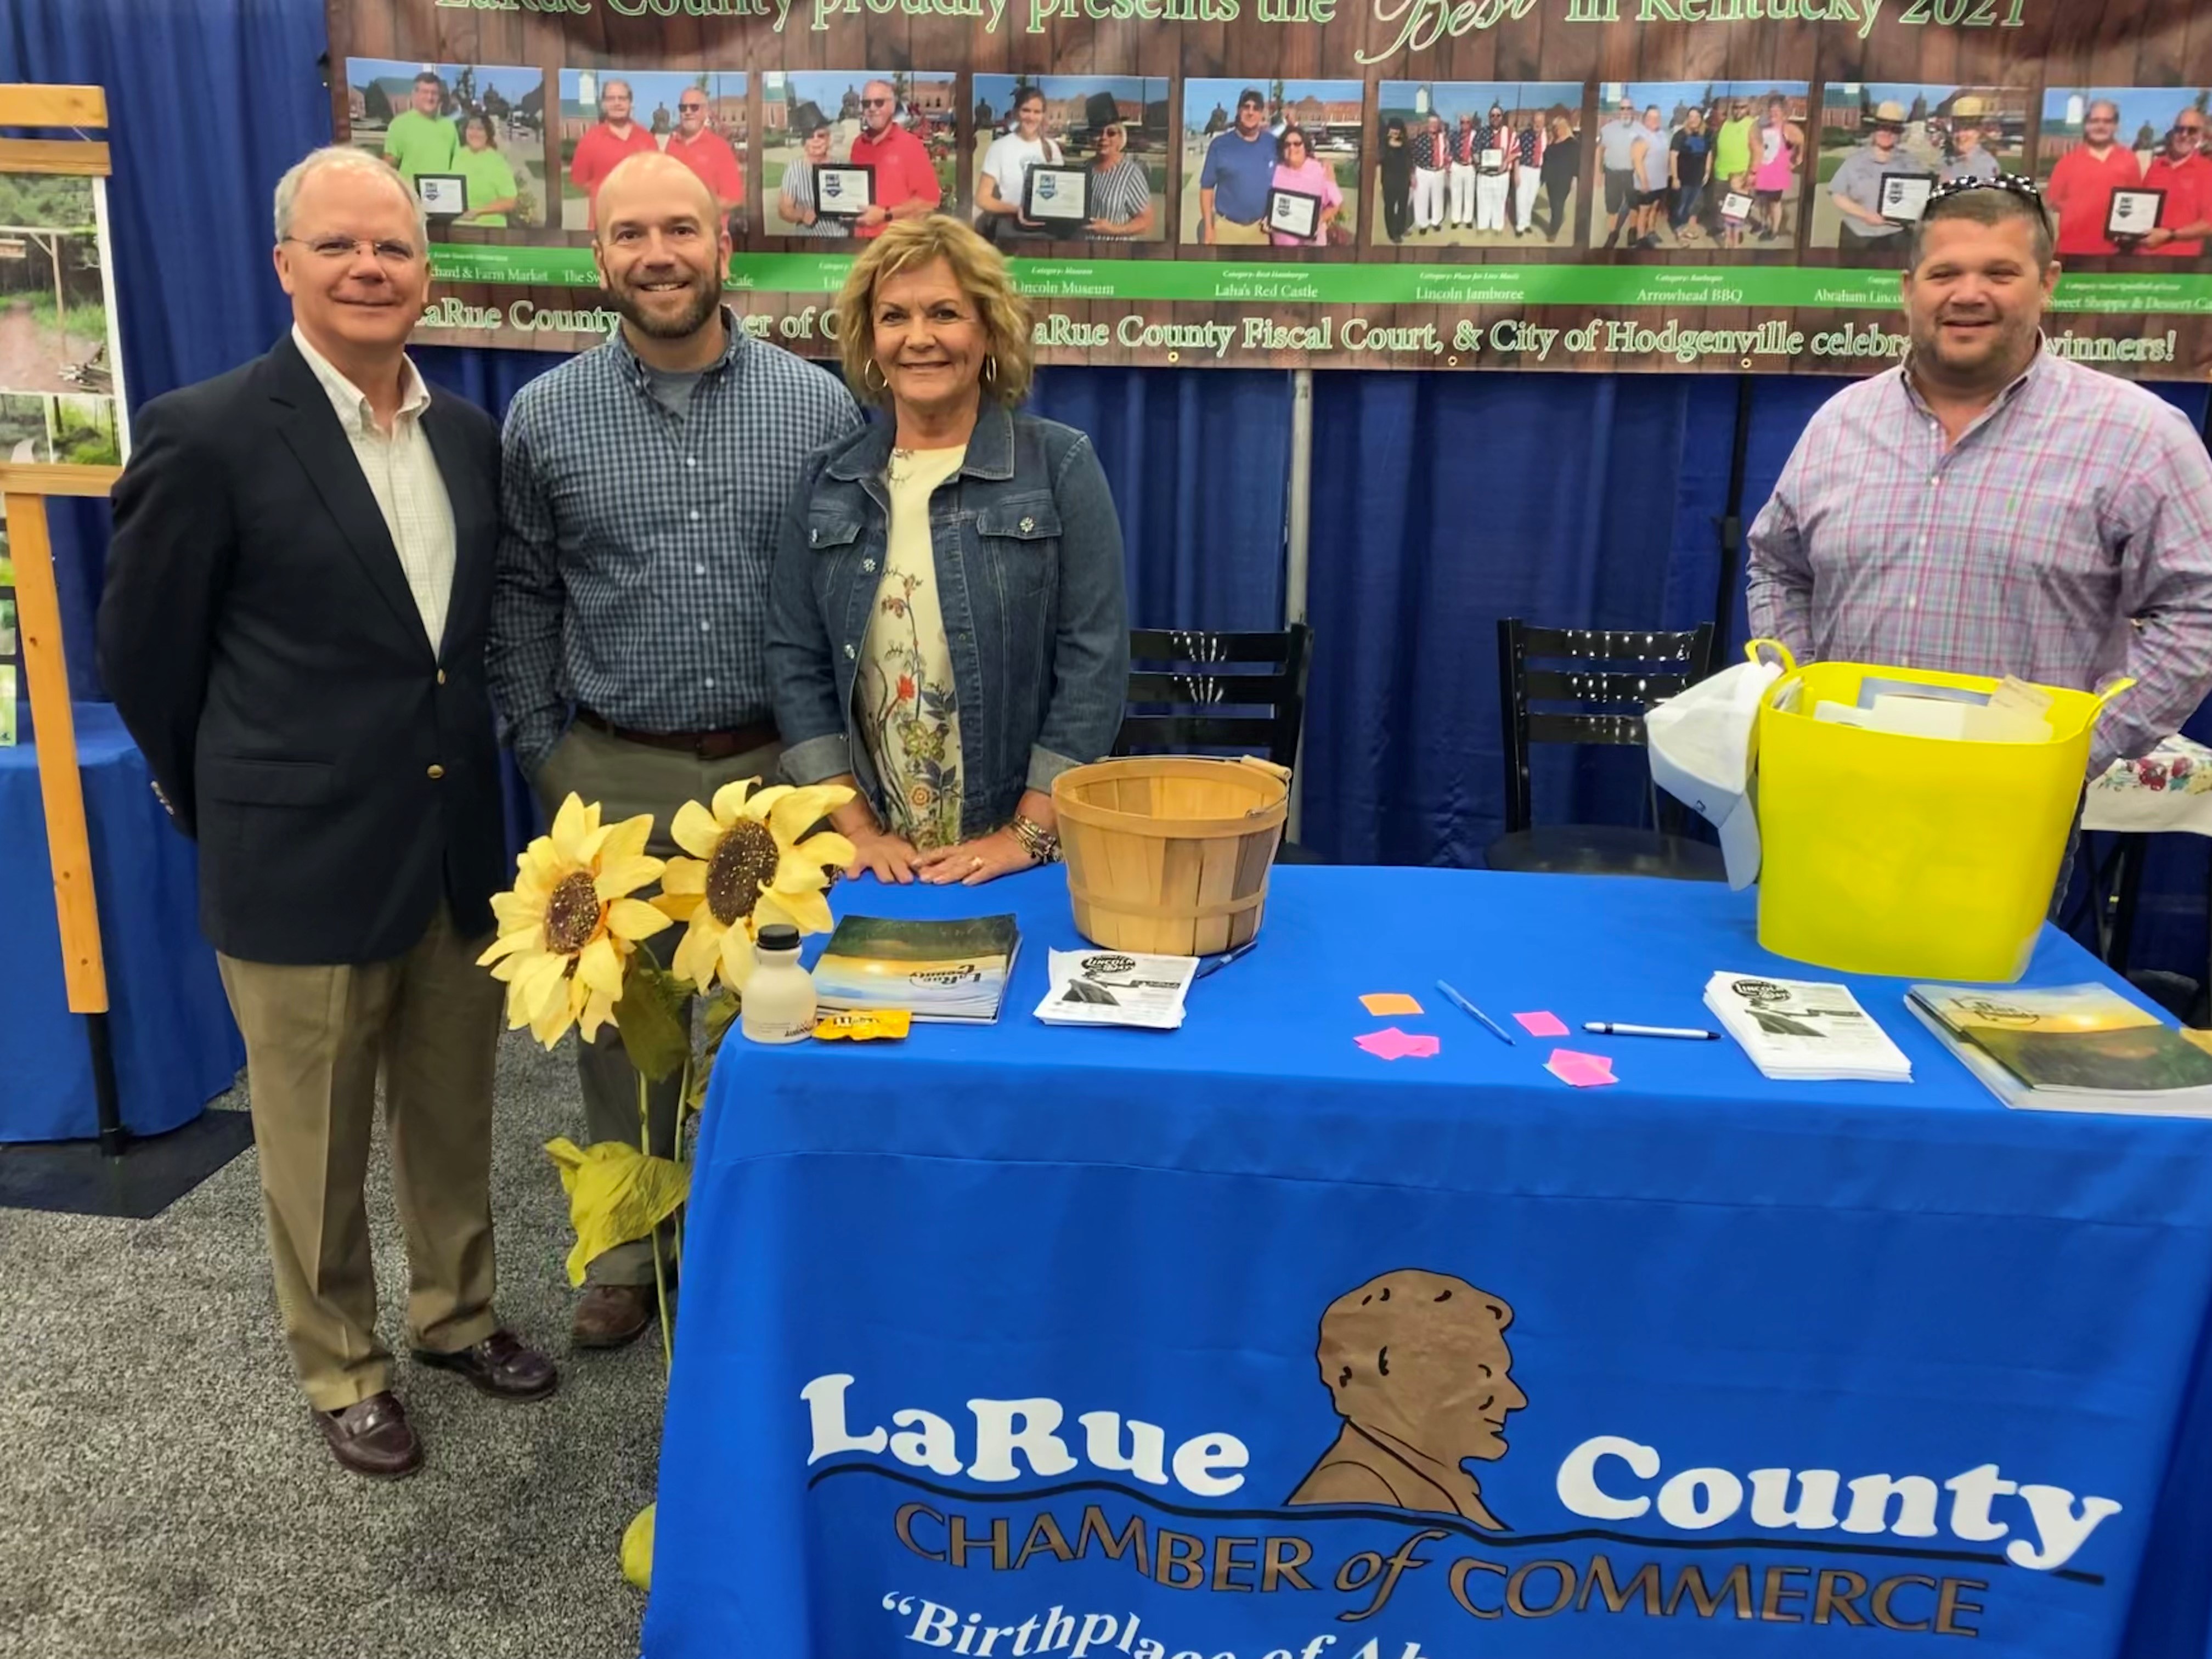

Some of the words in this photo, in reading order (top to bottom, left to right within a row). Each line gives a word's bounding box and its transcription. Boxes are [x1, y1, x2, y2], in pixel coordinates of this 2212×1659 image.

[509, 300, 622, 341] County
[780, 305, 816, 338] of
[1031, 314, 1110, 346] aRue
[1116, 315, 1237, 358] County
[1241, 317, 1333, 349] Fiscal
[1341, 318, 1444, 354] Court,
[1453, 320, 1483, 351] &
[1489, 320, 1560, 361] City
[1564, 318, 1603, 352] of
[1604, 319, 1804, 363] Hodgenville
[800, 1373, 1250, 1497] LaRue
[1556, 1435, 2123, 1570] County
[894, 1502, 1318, 1593] CHAMBER
[1334, 1530, 1449, 1622] of
[1448, 1555, 1989, 1637] COMMERCE
